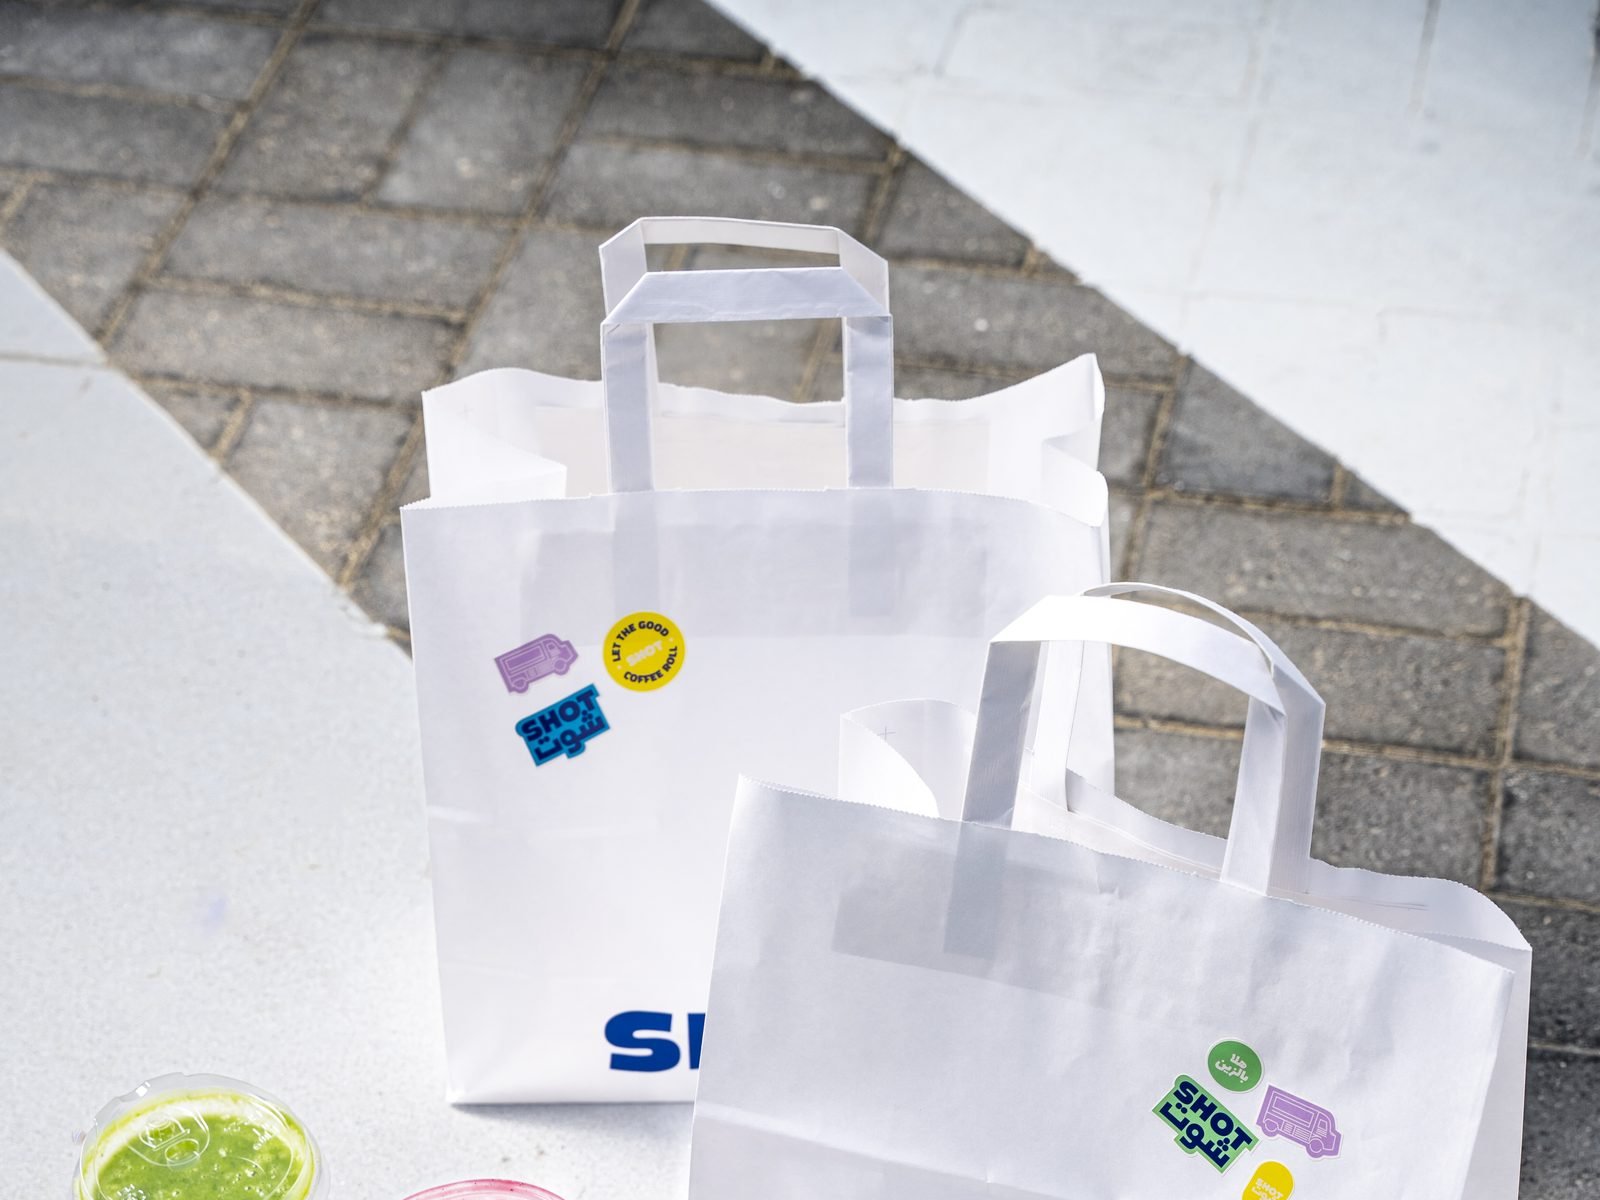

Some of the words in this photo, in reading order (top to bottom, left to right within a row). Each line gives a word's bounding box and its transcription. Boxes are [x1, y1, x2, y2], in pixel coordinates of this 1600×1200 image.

[616, 623, 636, 640] THE
[638, 620, 669, 637] GOOD
[612, 642, 621, 662] LET
[623, 670, 664, 683] COFFEE
[662, 646, 678, 672] ROLL
[521, 689, 595, 741] SHOT
[534, 709, 605, 760] شوت
[1230, 1053, 1247, 1069] هلا
[1173, 1081, 1253, 1151] SHOT
[1159, 1101, 1230, 1168] شوت
[1255, 1178, 1284, 1199] SHOT
